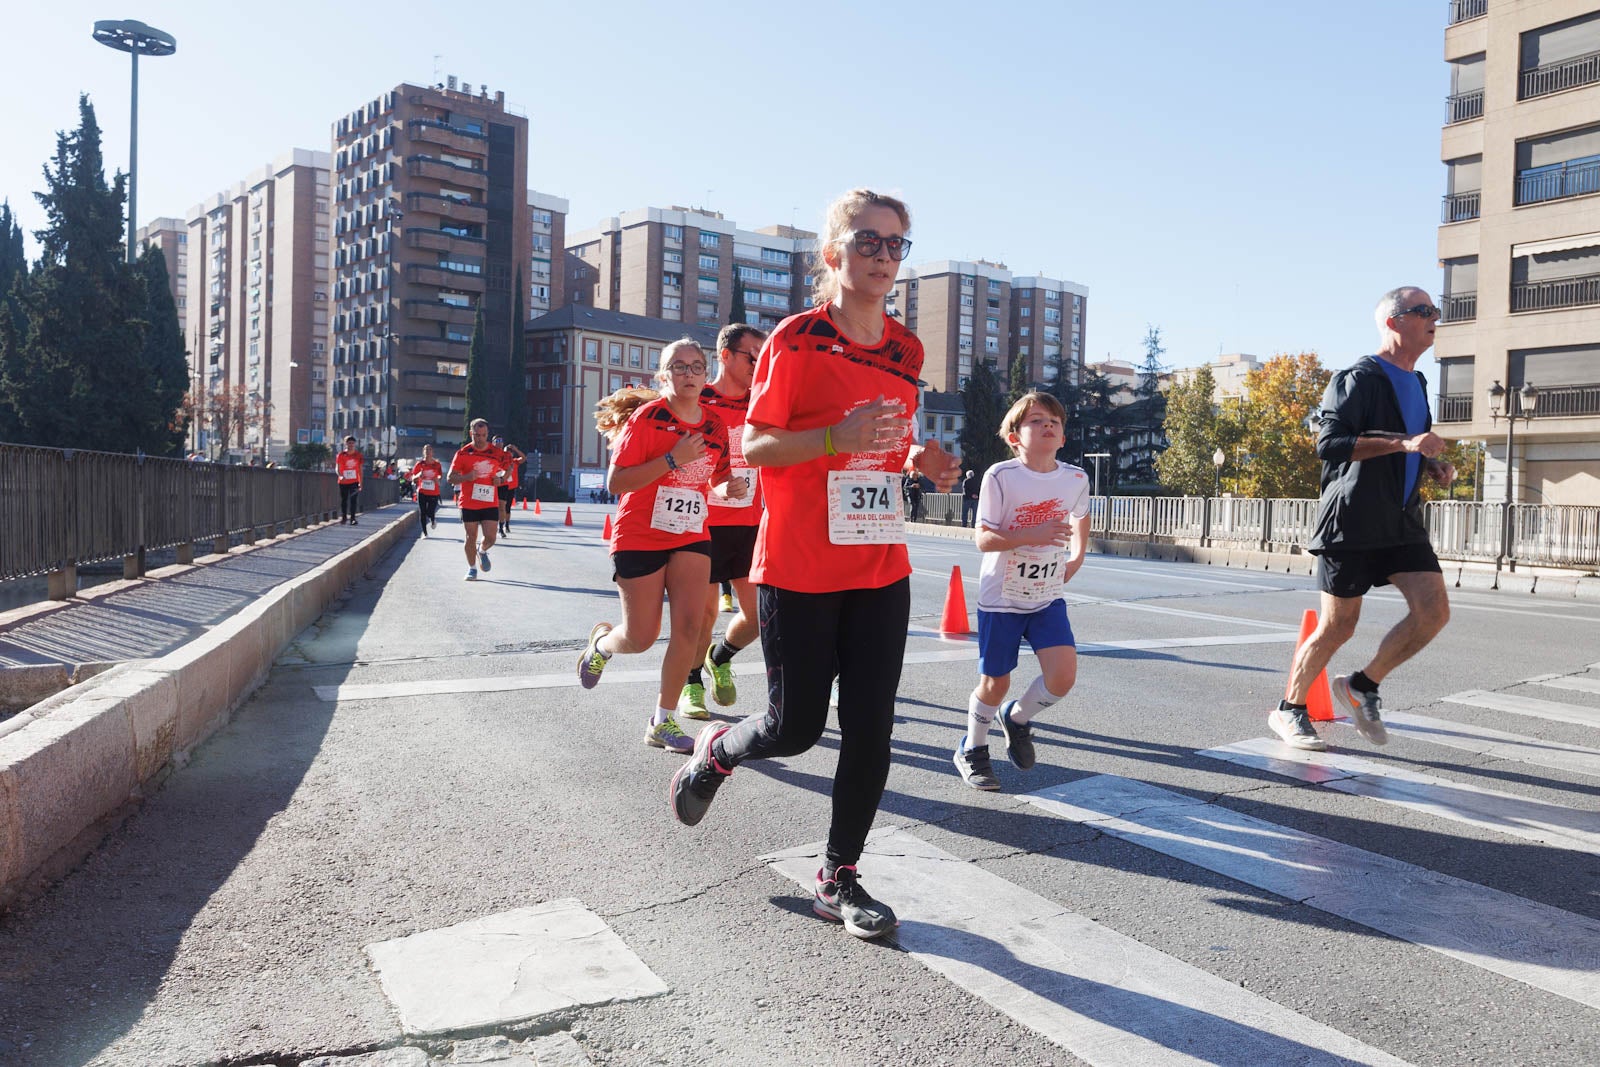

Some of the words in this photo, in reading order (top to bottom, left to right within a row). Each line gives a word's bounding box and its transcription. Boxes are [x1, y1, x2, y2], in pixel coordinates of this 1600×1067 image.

[850, 487, 890, 508] 374
[665, 498, 700, 514] 1215
[1017, 562, 1058, 578] 1217
